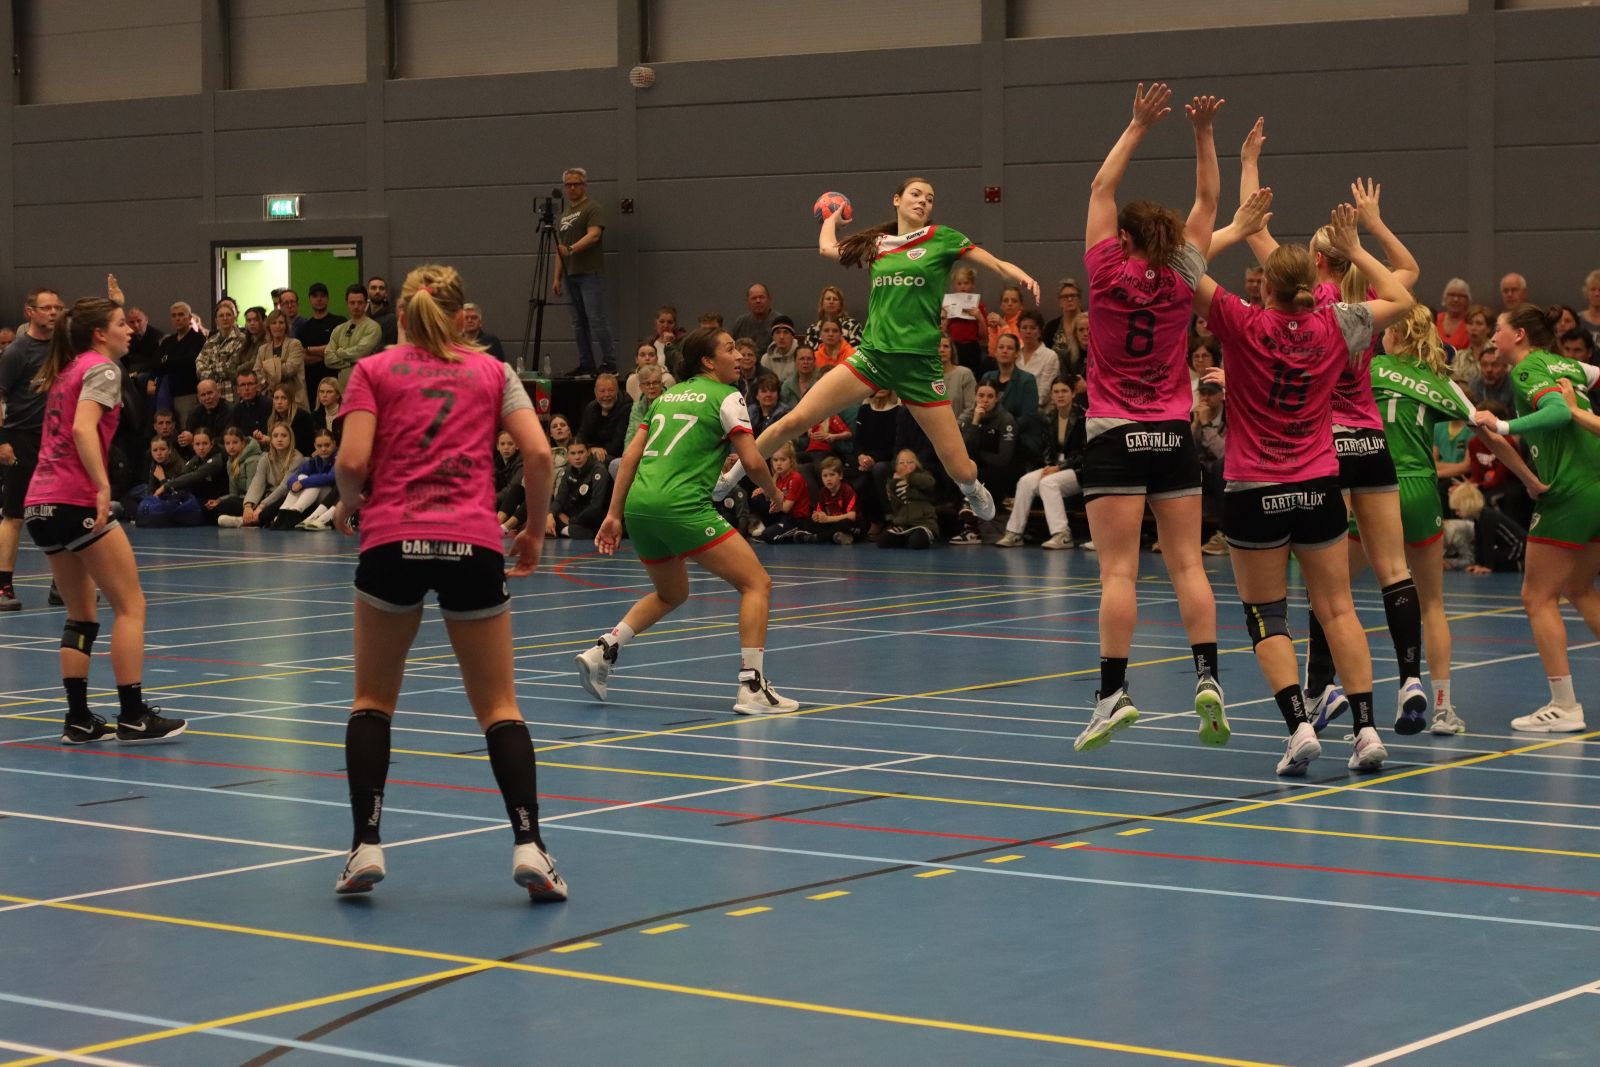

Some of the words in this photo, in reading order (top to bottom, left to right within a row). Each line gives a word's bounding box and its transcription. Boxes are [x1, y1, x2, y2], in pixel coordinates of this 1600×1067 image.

[873, 271, 925, 288] enéco
[1125, 309, 1156, 357] 8
[1267, 361, 1312, 412] 18
[1379, 367, 1457, 411] venéco
[420, 387, 456, 448] 7
[642, 413, 699, 457] 27
